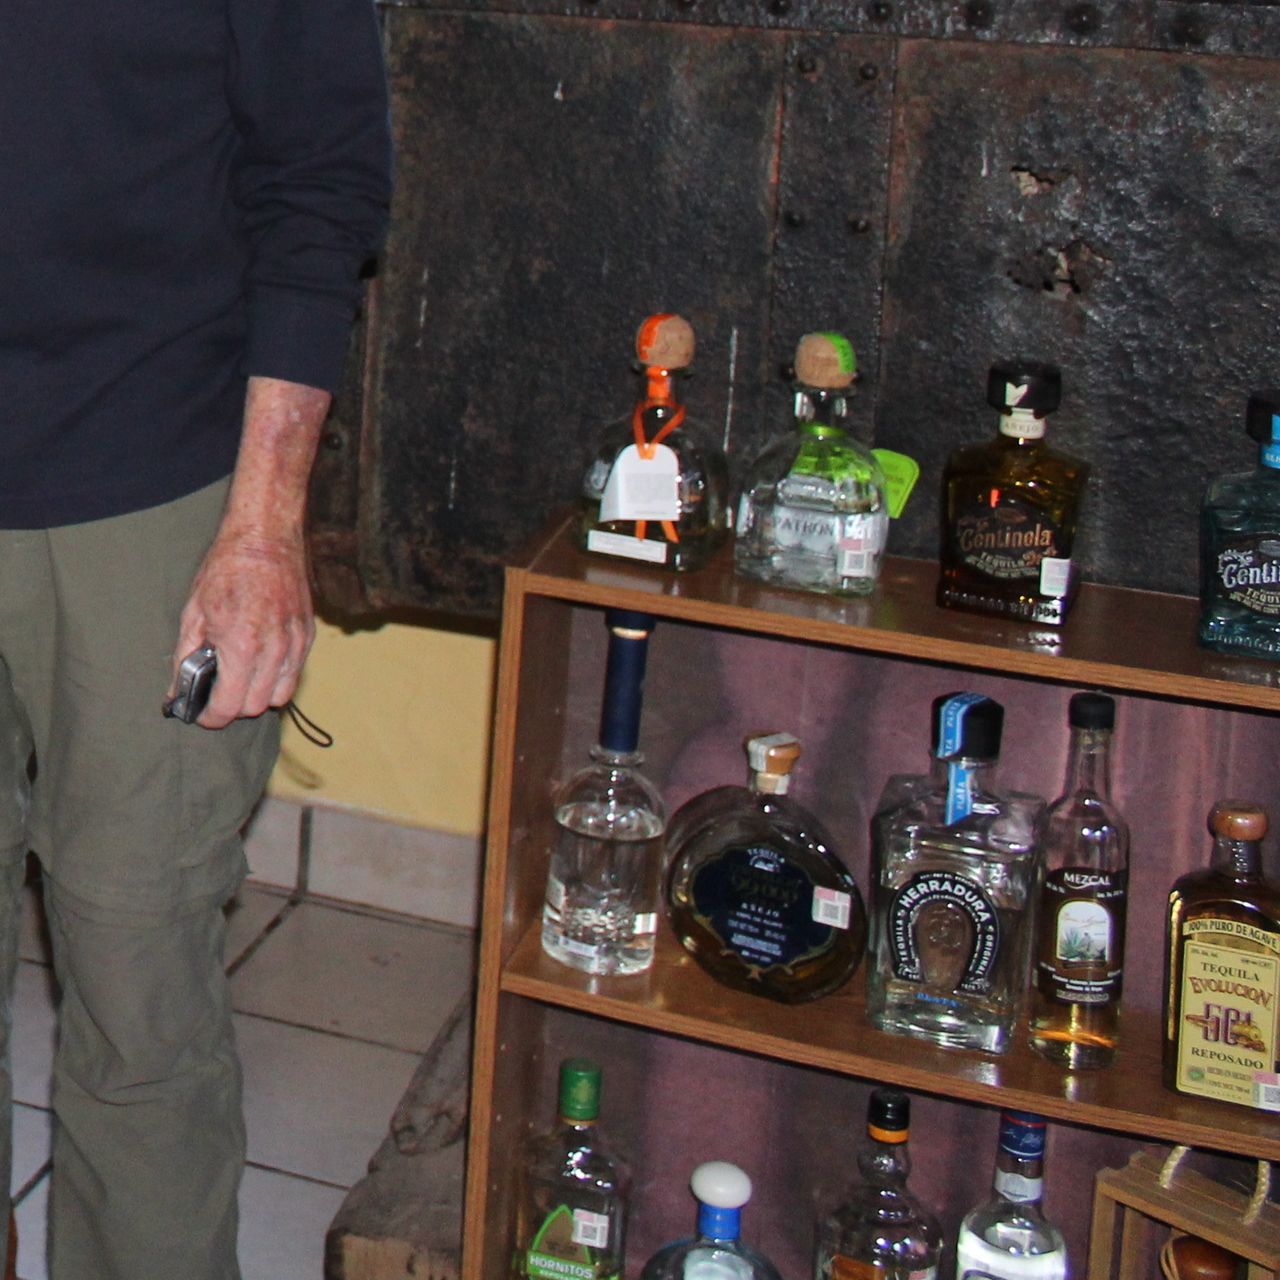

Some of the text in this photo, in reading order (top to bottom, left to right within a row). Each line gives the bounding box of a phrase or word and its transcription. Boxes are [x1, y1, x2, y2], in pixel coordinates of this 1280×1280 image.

[1063, 871, 1112, 887] MEZCAL
[898, 879, 992, 923] HERRADURA
[1209, 920, 1235, 933] PURO
[1236, 924, 1248, 936] DE
[1248, 928, 1279, 949] AGAVE
[1200, 960, 1261, 982] TEQUILA
[1191, 1046, 1265, 1070] REPOSADO
[530, 1254, 594, 1280] HORNITOS
